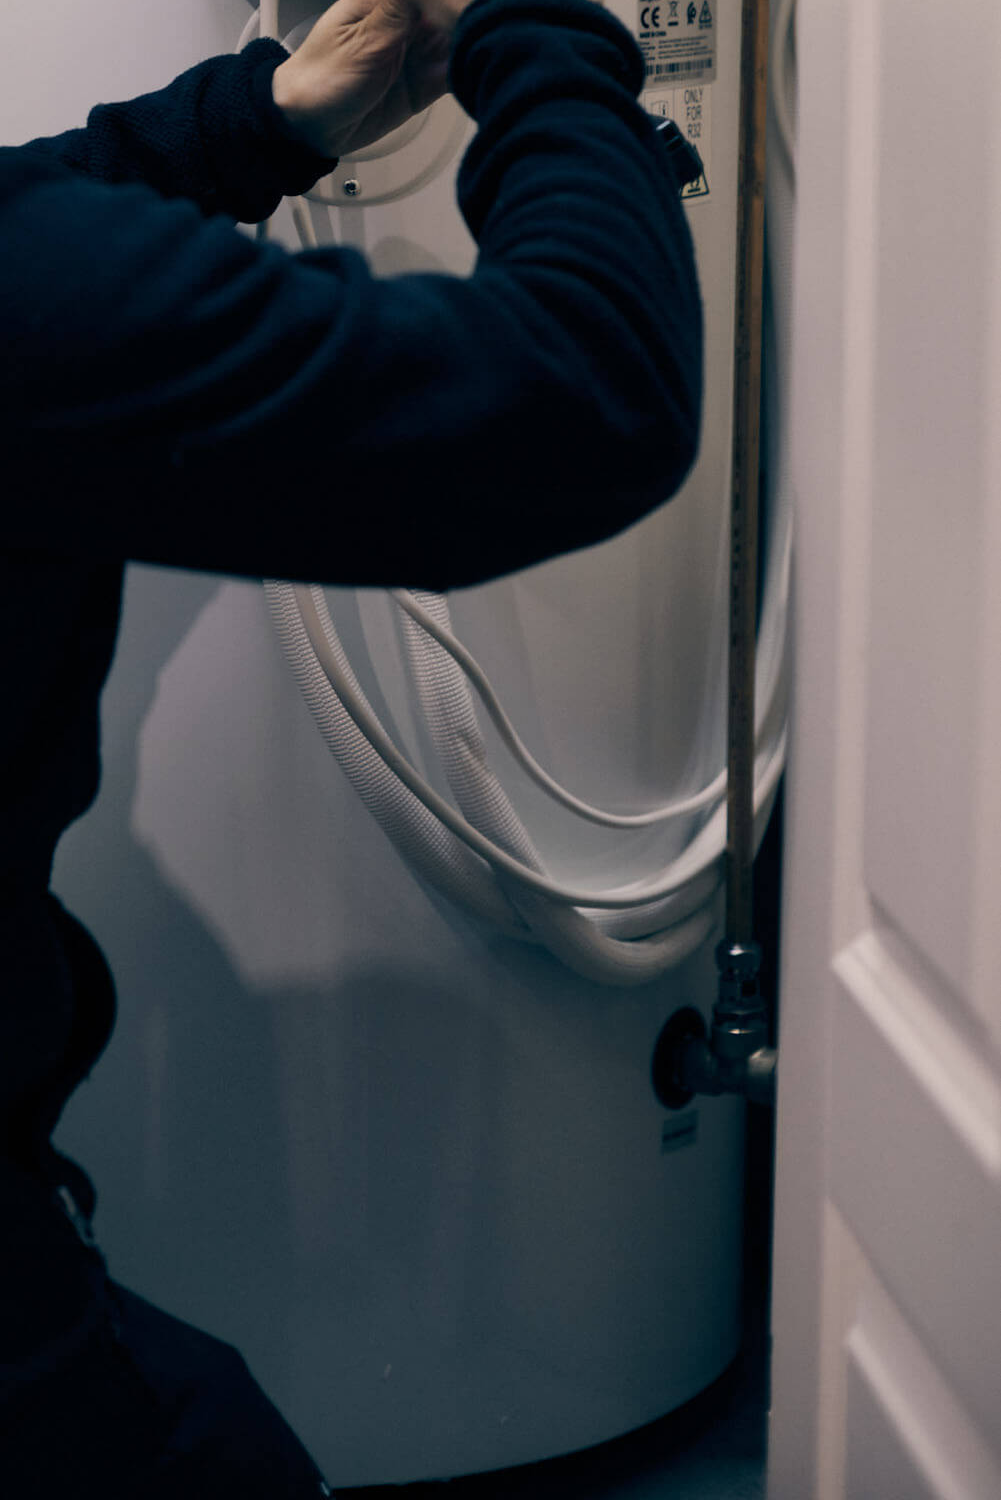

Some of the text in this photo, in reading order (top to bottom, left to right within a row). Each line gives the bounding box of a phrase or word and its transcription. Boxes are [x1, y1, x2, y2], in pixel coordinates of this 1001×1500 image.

[640, 6, 661, 29] CE
[685, 88, 703, 104] ONLY
[687, 105, 702, 120] FOR
[688, 123, 702, 138] R32
